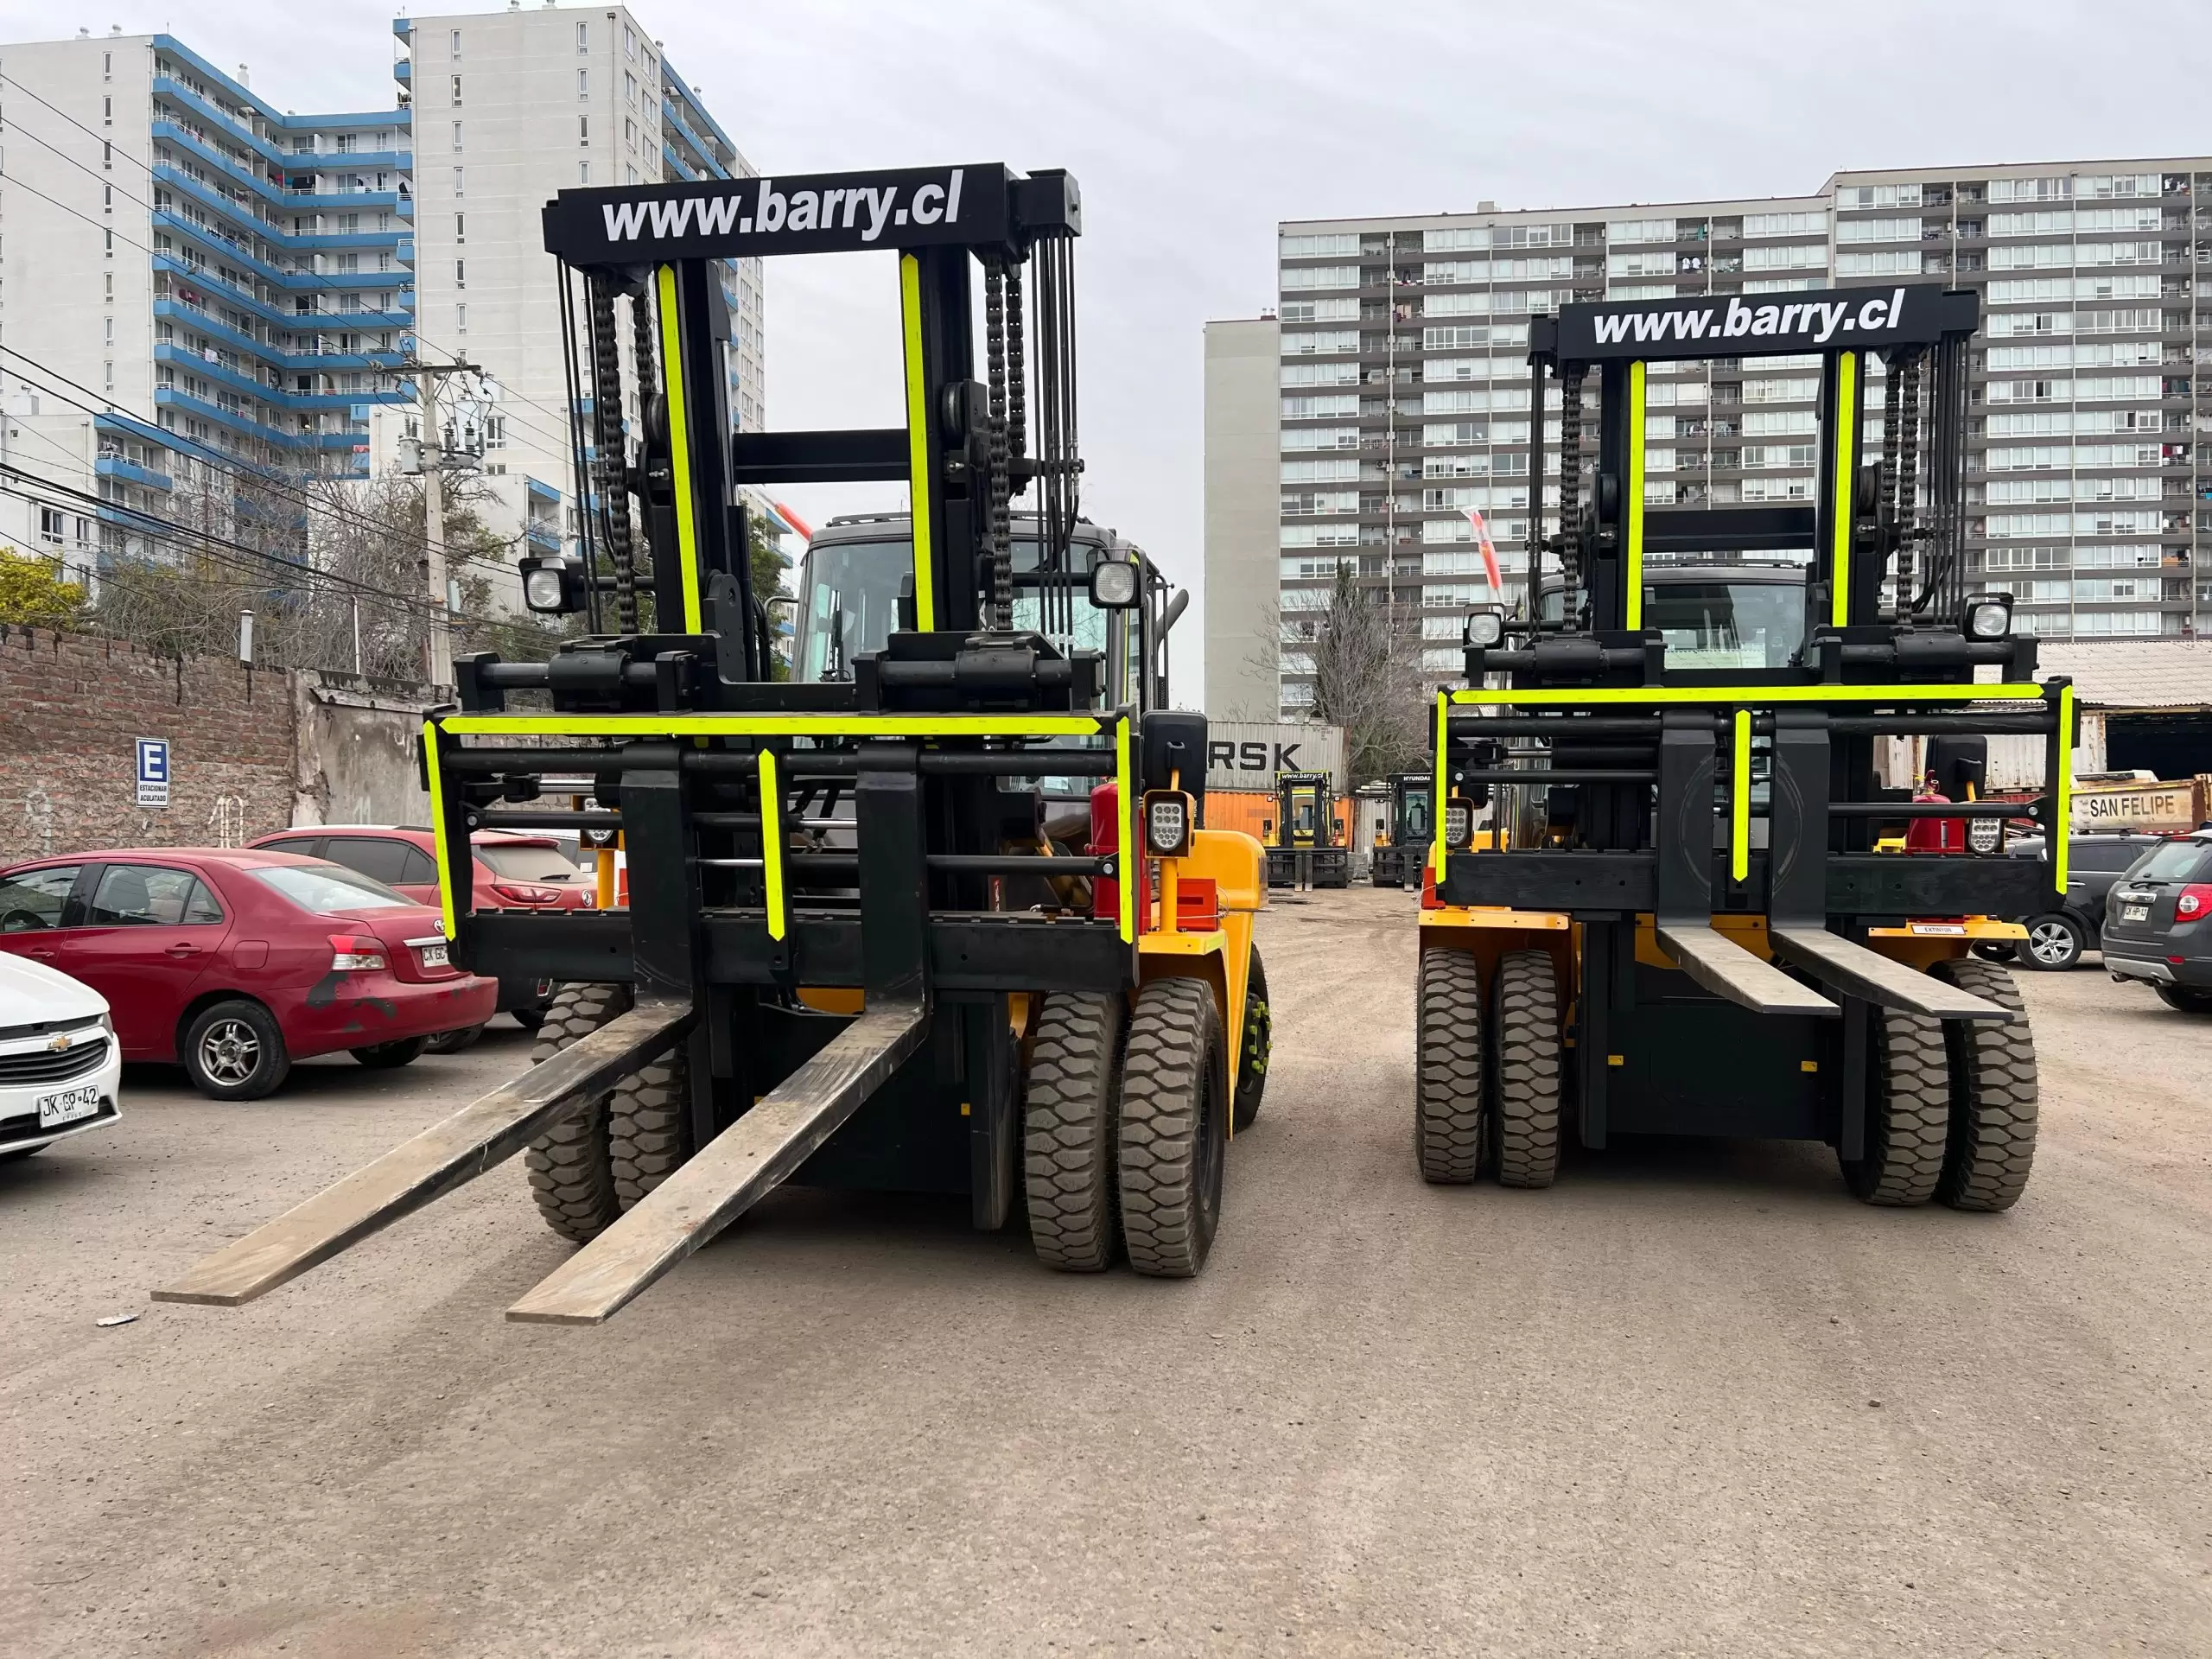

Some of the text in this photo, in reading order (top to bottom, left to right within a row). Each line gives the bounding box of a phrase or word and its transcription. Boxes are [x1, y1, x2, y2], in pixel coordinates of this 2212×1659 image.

[602, 168, 964, 241] www.barry.cl
[1593, 288, 1905, 343] www.barry.cl
[143, 744, 163, 779] E
[2090, 795, 2175, 817] SAN FELIPE
